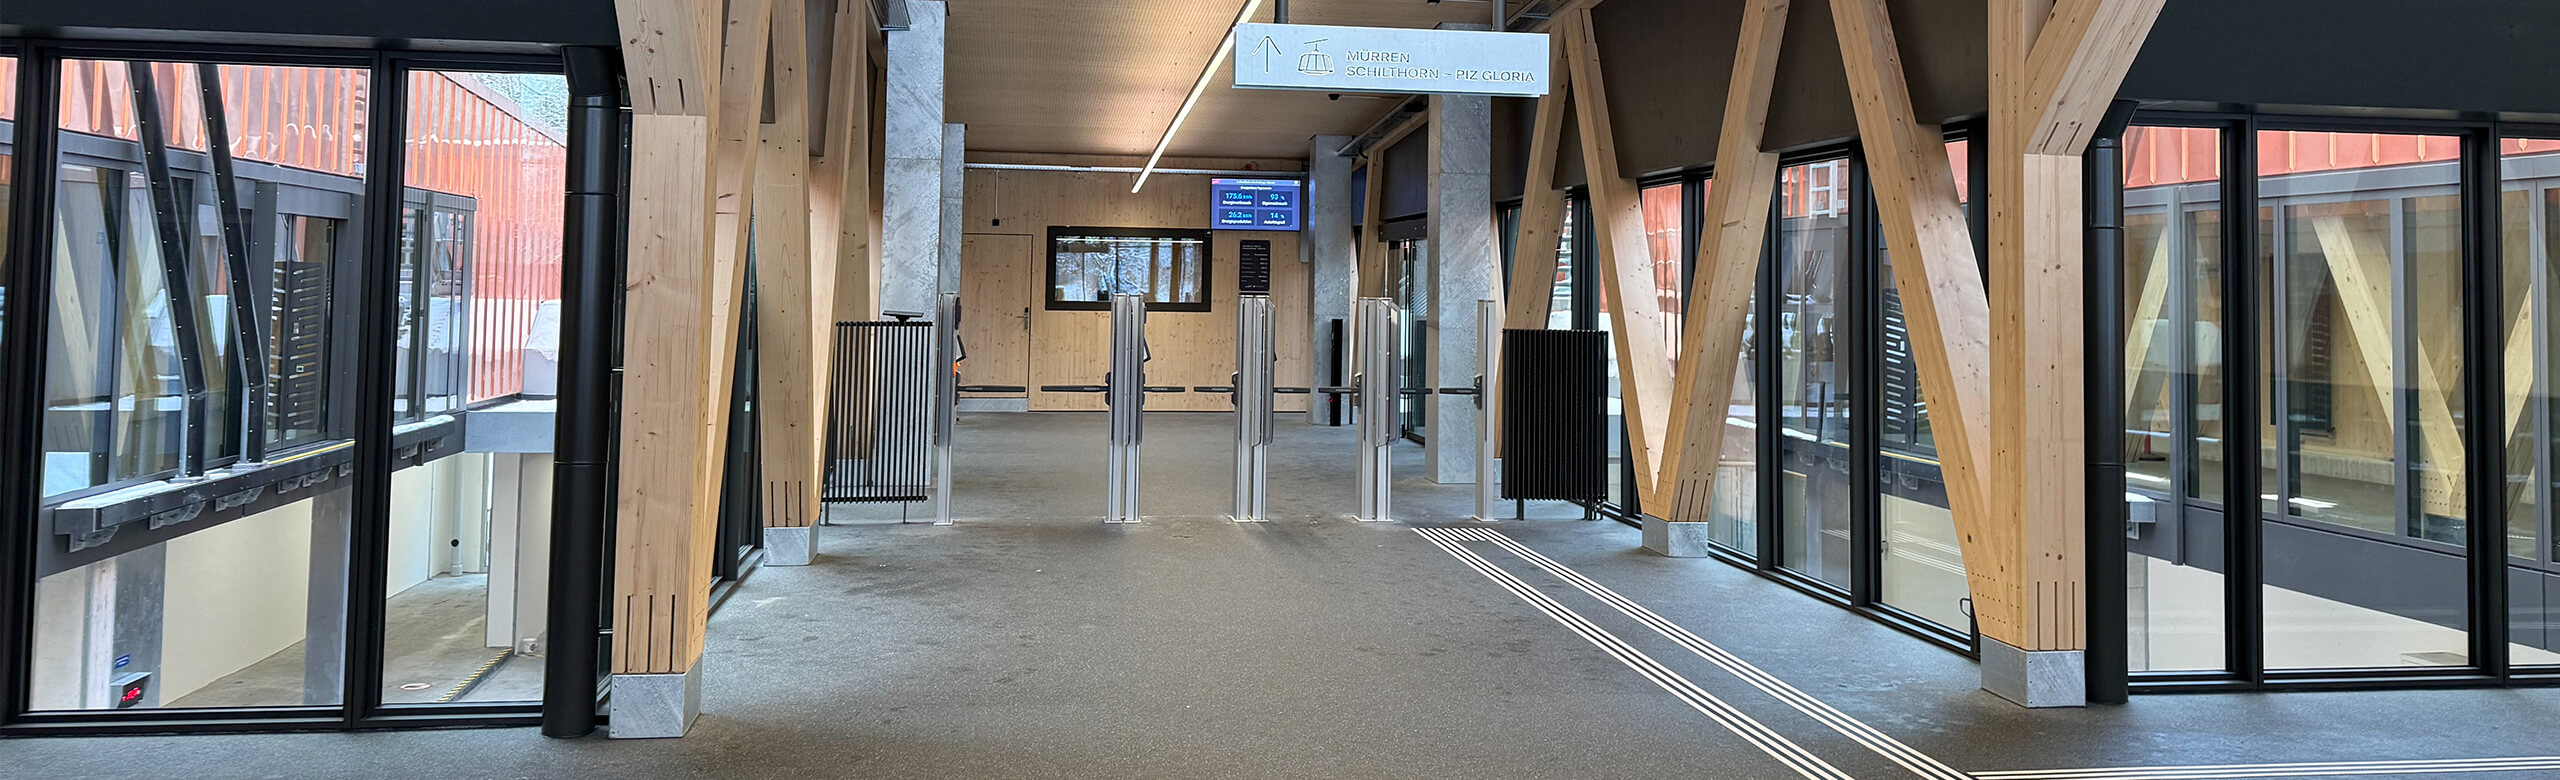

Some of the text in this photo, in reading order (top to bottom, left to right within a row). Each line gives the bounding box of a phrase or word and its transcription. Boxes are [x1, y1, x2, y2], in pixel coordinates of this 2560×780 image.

[1347, 49, 1410, 63] MÜRREN
[1346, 66, 1439, 79] SCHILTHORN
[1456, 69, 1478, 80] PIZ
[1481, 70, 1535, 81] GLORIA
[1270, 193, 1279, 201] 93
